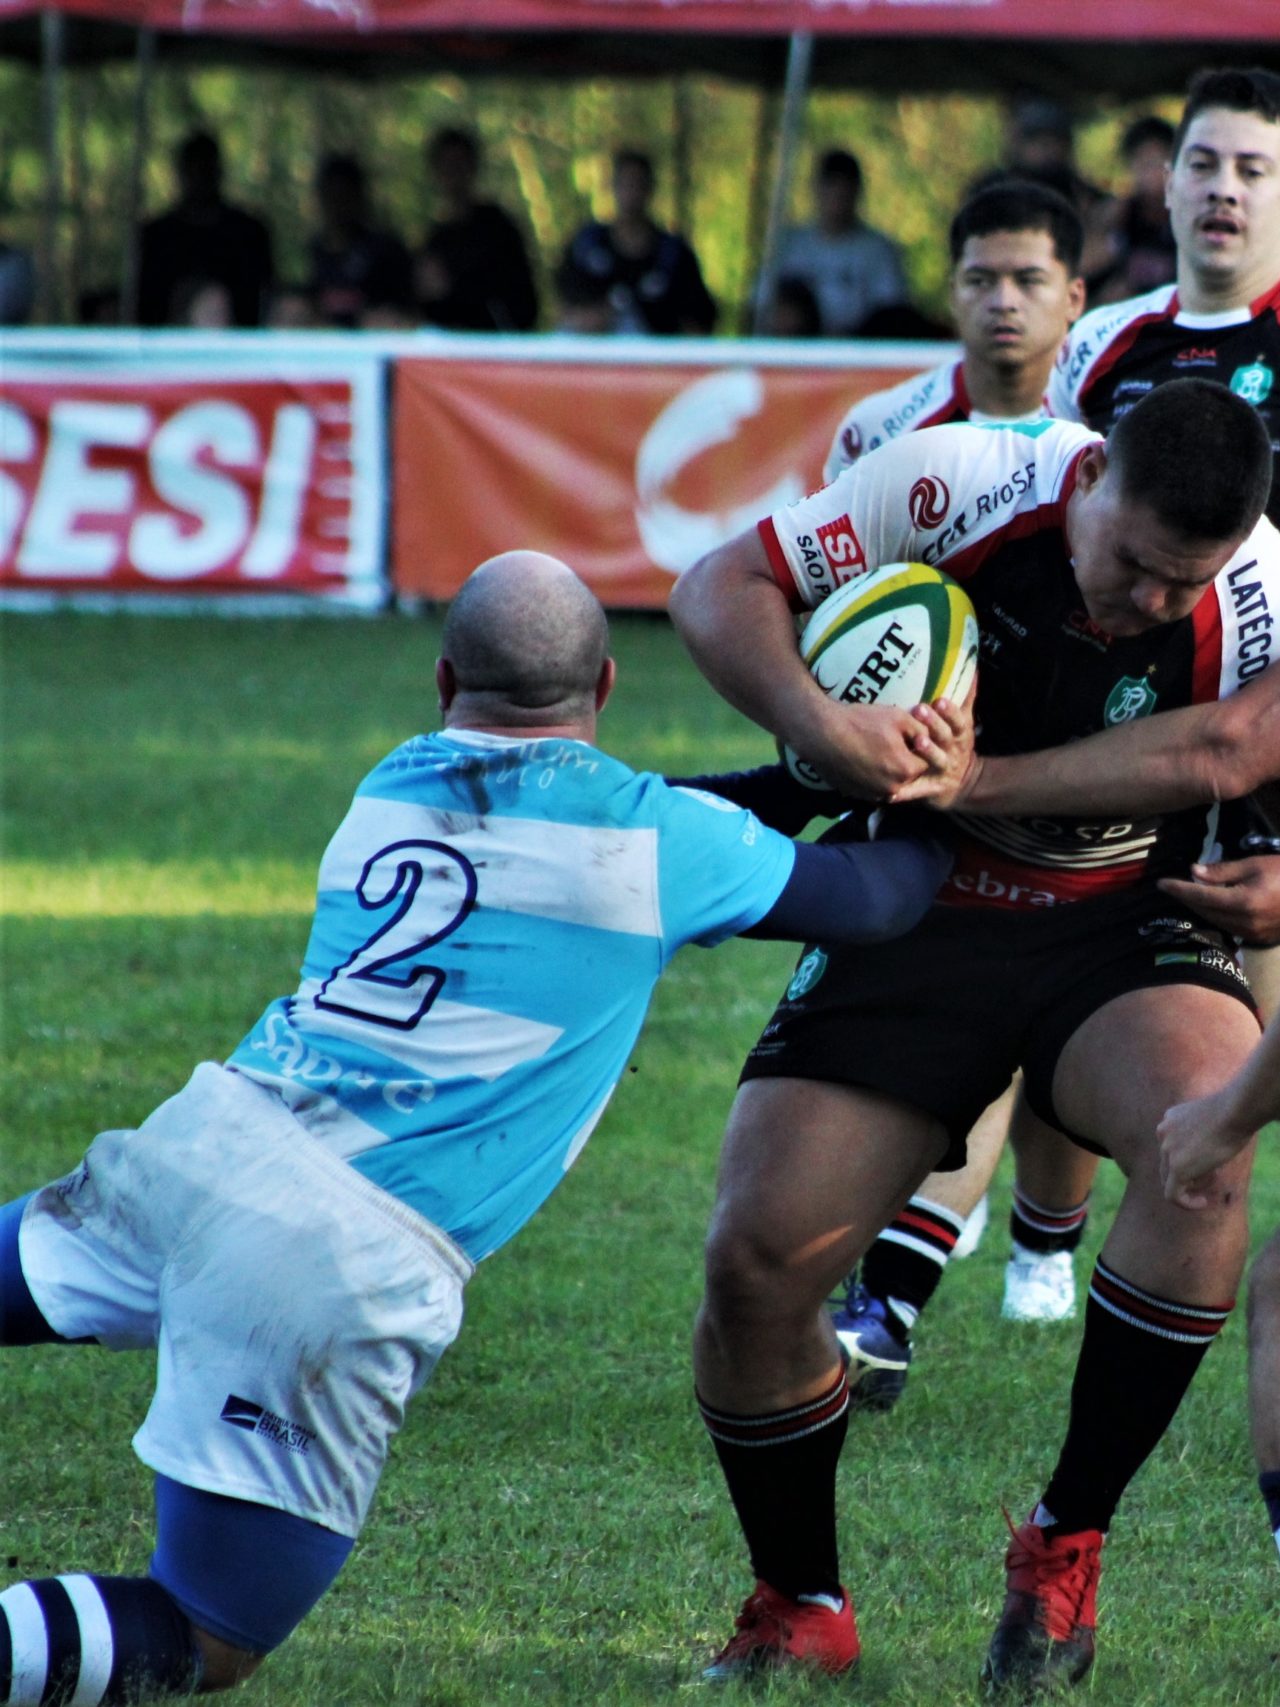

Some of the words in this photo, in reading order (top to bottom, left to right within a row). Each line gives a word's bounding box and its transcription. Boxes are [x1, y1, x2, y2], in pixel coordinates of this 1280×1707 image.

[1227, 559, 1275, 690] LATÉCO
[314, 838, 479, 1031] 2
[258, 1416, 310, 1452] BRASIL
